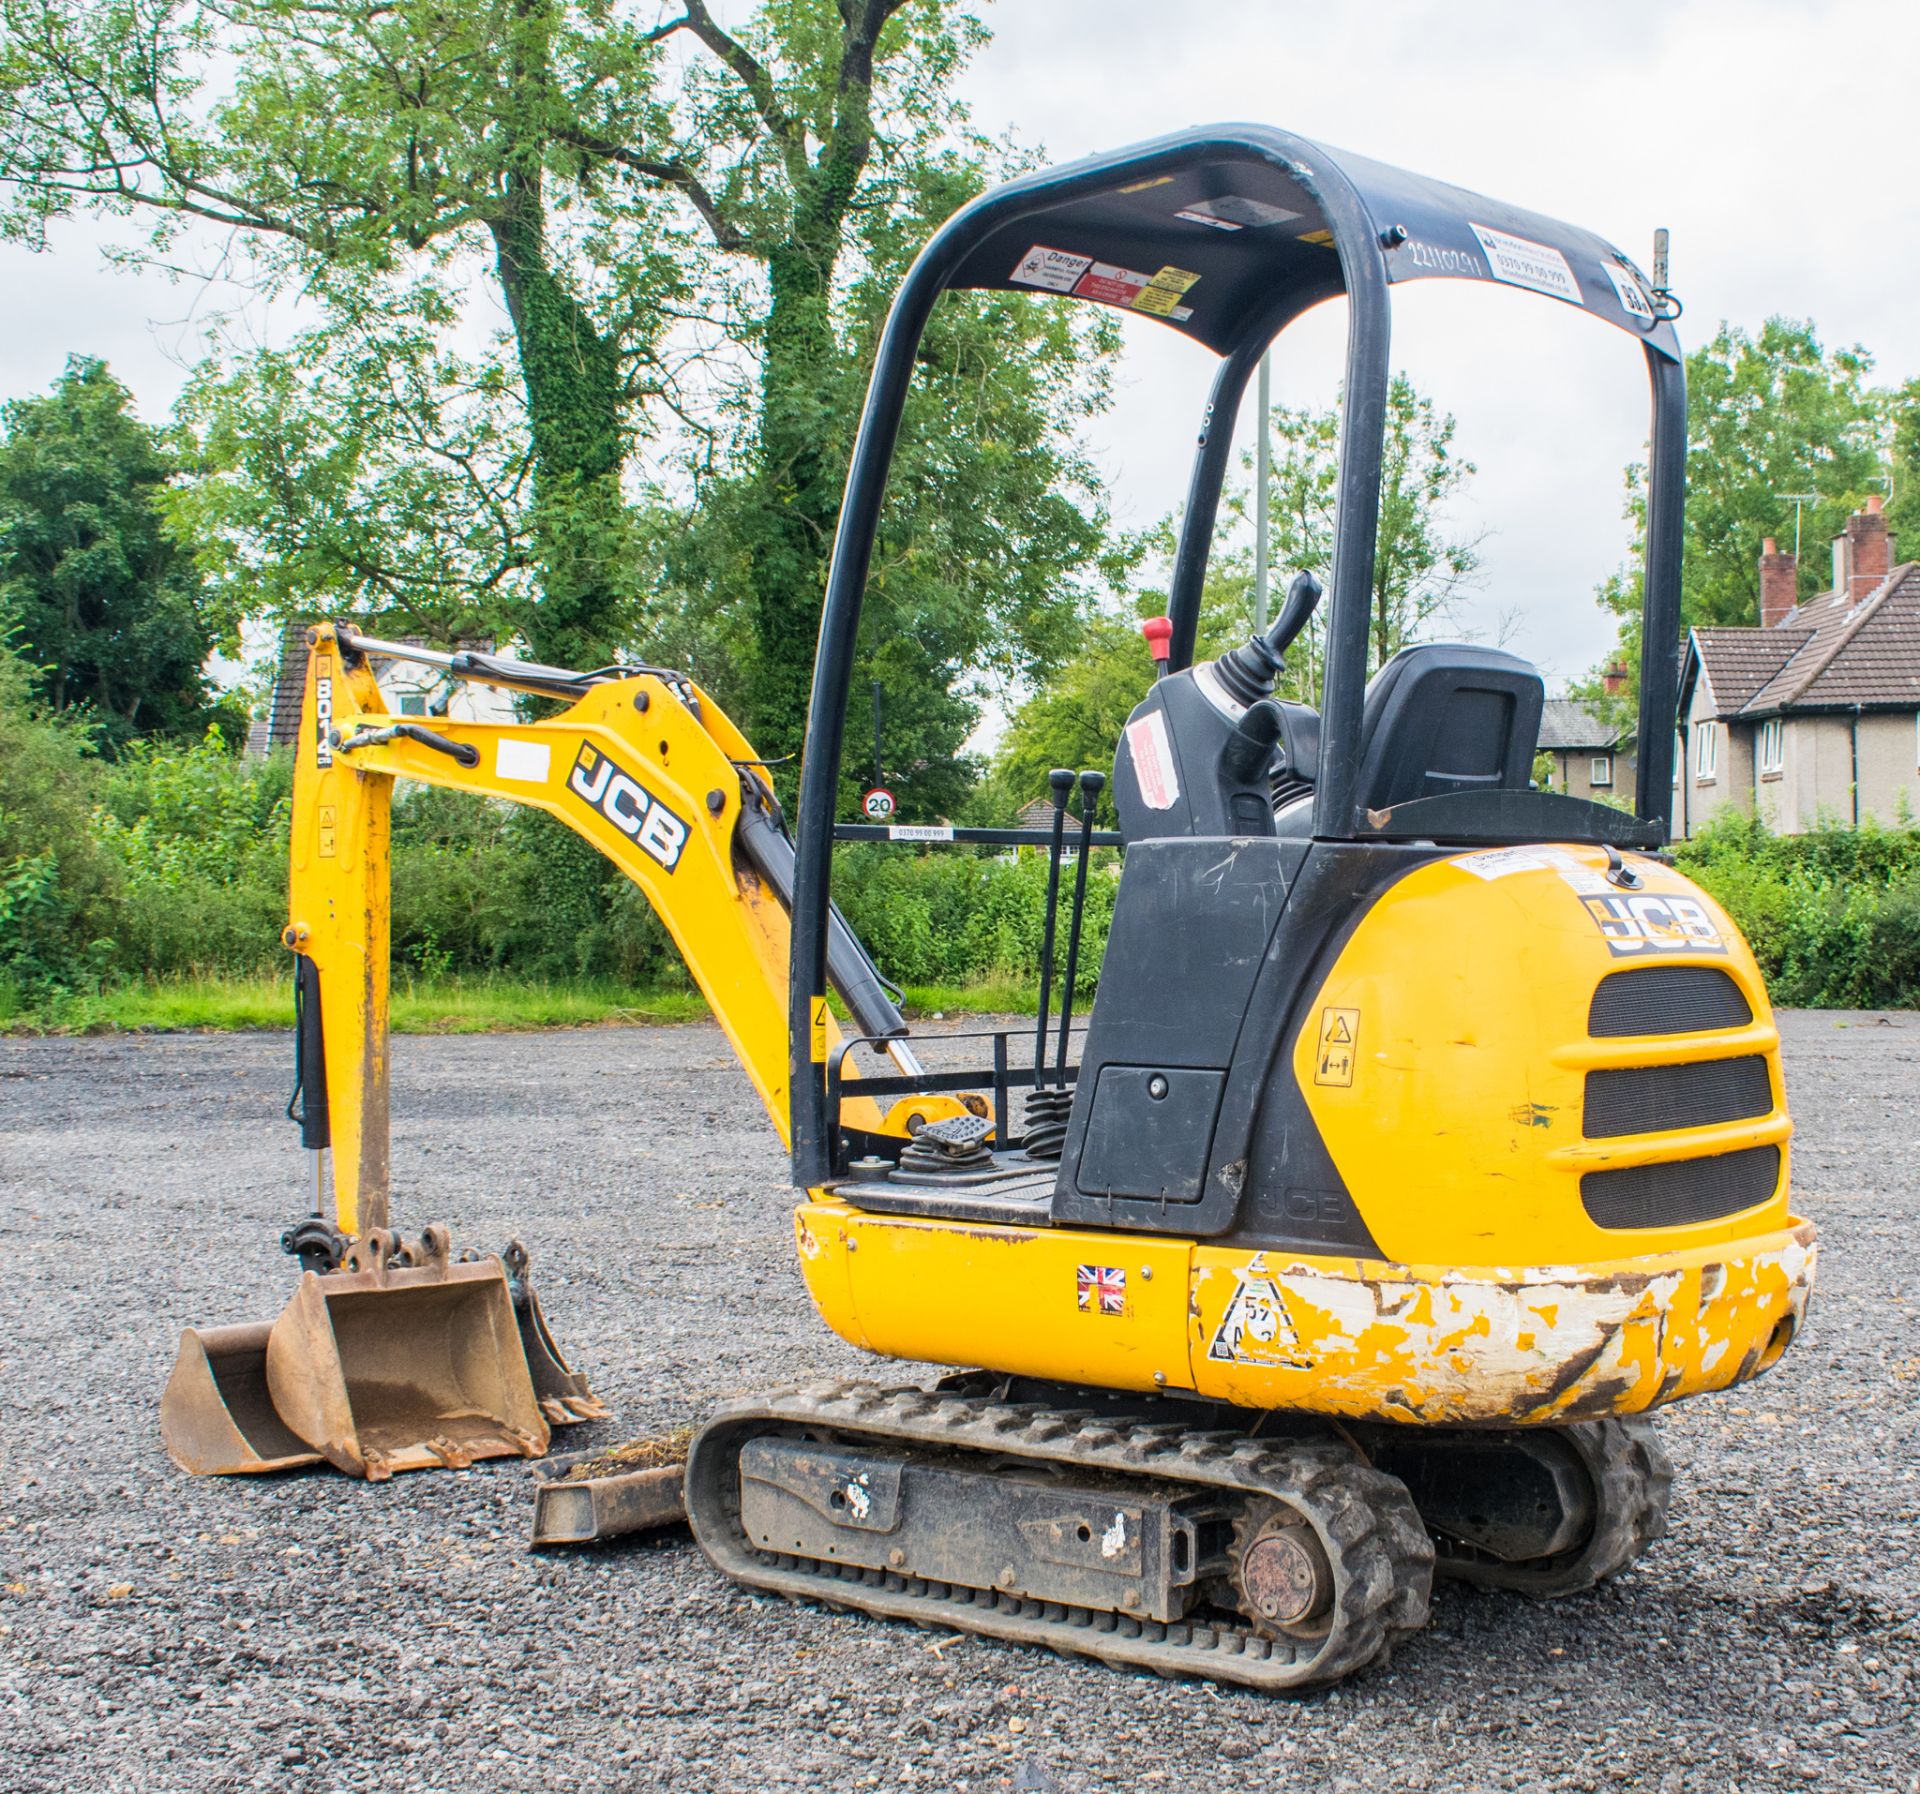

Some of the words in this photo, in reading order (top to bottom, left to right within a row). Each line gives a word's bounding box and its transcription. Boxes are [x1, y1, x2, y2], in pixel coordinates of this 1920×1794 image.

[1048, 252, 1089, 268] Danger
[1408, 242, 1482, 276] 22110291
[317, 679, 331, 757] 8014
[573, 759, 686, 868] JCB
[868, 798, 891, 812] 20
[1602, 897, 1722, 950] JCB
[1258, 1186, 1349, 1223] JCB
